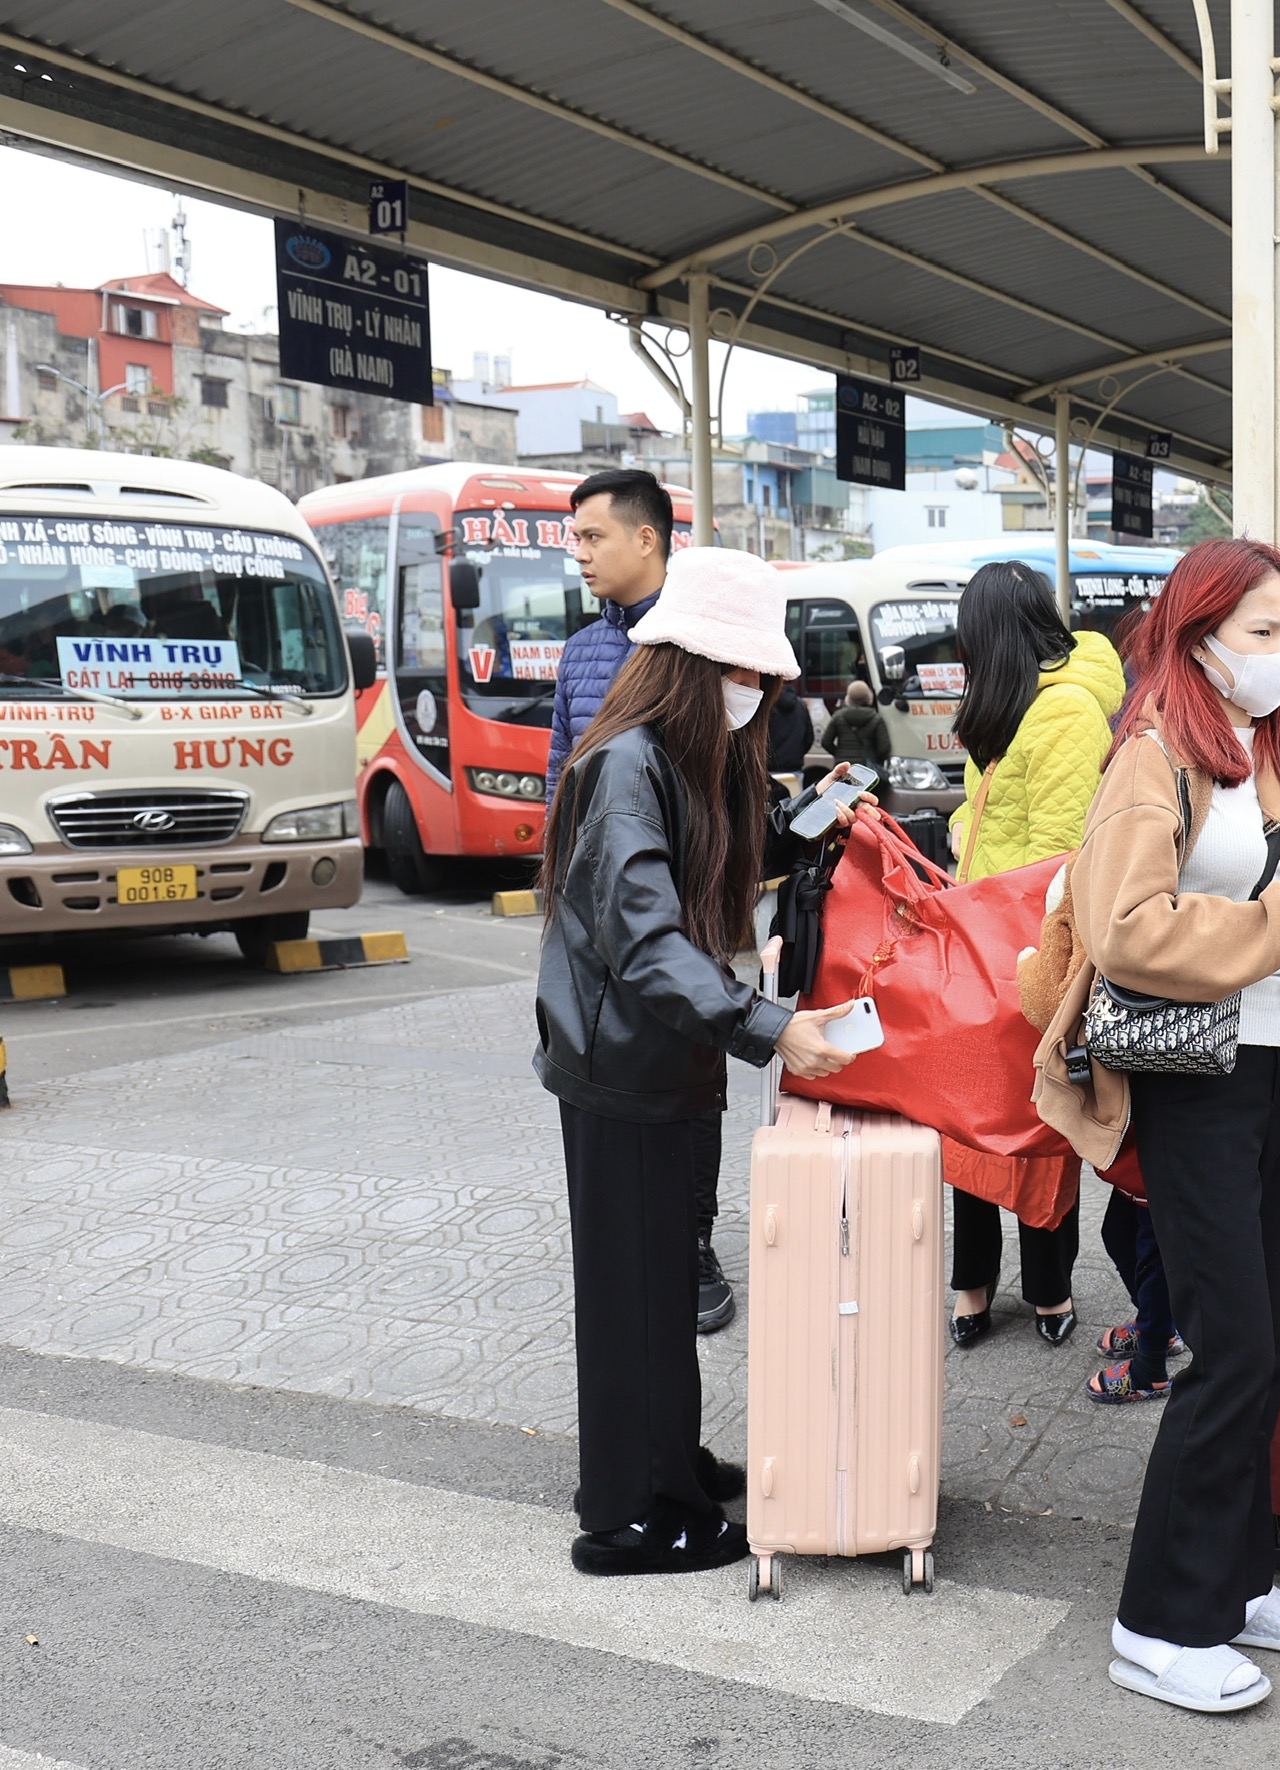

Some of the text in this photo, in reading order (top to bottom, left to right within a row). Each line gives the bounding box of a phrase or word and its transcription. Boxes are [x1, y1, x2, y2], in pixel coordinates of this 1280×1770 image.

[370, 185, 384, 200] A2
[377, 199, 402, 229] 01
[288, 287, 323, 325] VĨNH
[325, 300, 353, 338] TRỤ
[364, 307, 379, 338] LÝ
[384, 315, 422, 348] NHÂN
[895, 359, 917, 379] 02
[1150, 442, 1169, 456] 03
[55, 523, 91, 546] CHỢ
[92, 521, 138, 545] SÔNG
[145, 525, 184, 547] VĨNH
[184, 530, 214, 553] TRỤ
[461, 509, 582, 554] HẢI HẬ
[17, 542, 67, 565] NHÂN
[124, 548, 158, 573] CHỢ
[212, 554, 243, 578] CHỢ
[73, 638, 222, 668] VĨNH TRỤ
[469, 648, 495, 683] V
[512, 646, 564, 661] NAM ĐỊN
[67, 667, 101, 688] CÁT
[199, 701, 242, 720] GIÁP
[250, 701, 283, 719] BÁT
[174, 737, 293, 770] HƯNG
[141, 868, 174, 884] 90B
[127, 884, 188, 901] 001.67
